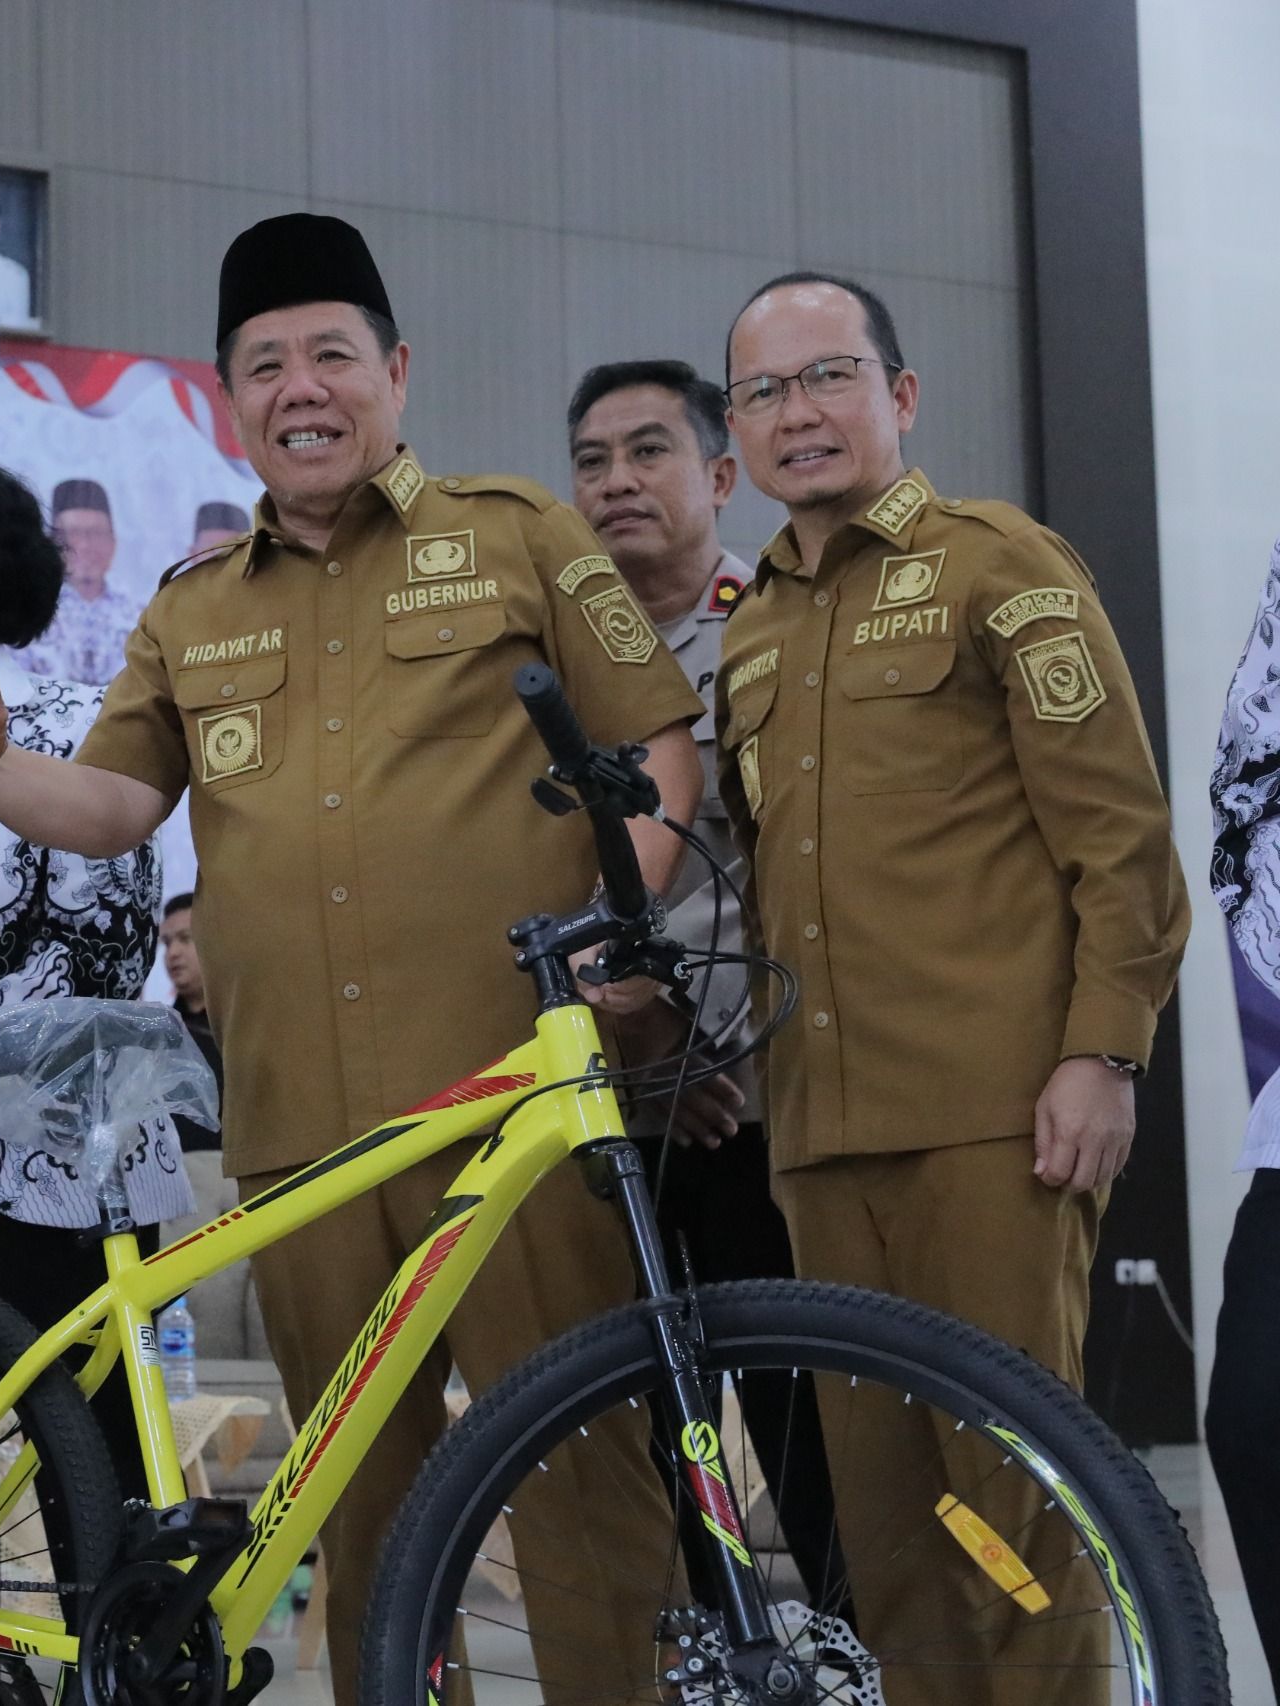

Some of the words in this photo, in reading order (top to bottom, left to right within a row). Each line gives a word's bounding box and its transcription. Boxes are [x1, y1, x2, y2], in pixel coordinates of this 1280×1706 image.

[386, 579, 498, 614] GUBERNUR
[999, 593, 1067, 621] PEMKAB
[853, 606, 948, 645] BUPATI
[183, 634, 257, 665] HIDAYAT
[258, 628, 282, 653] AR
[557, 912, 598, 935] SALZBURG
